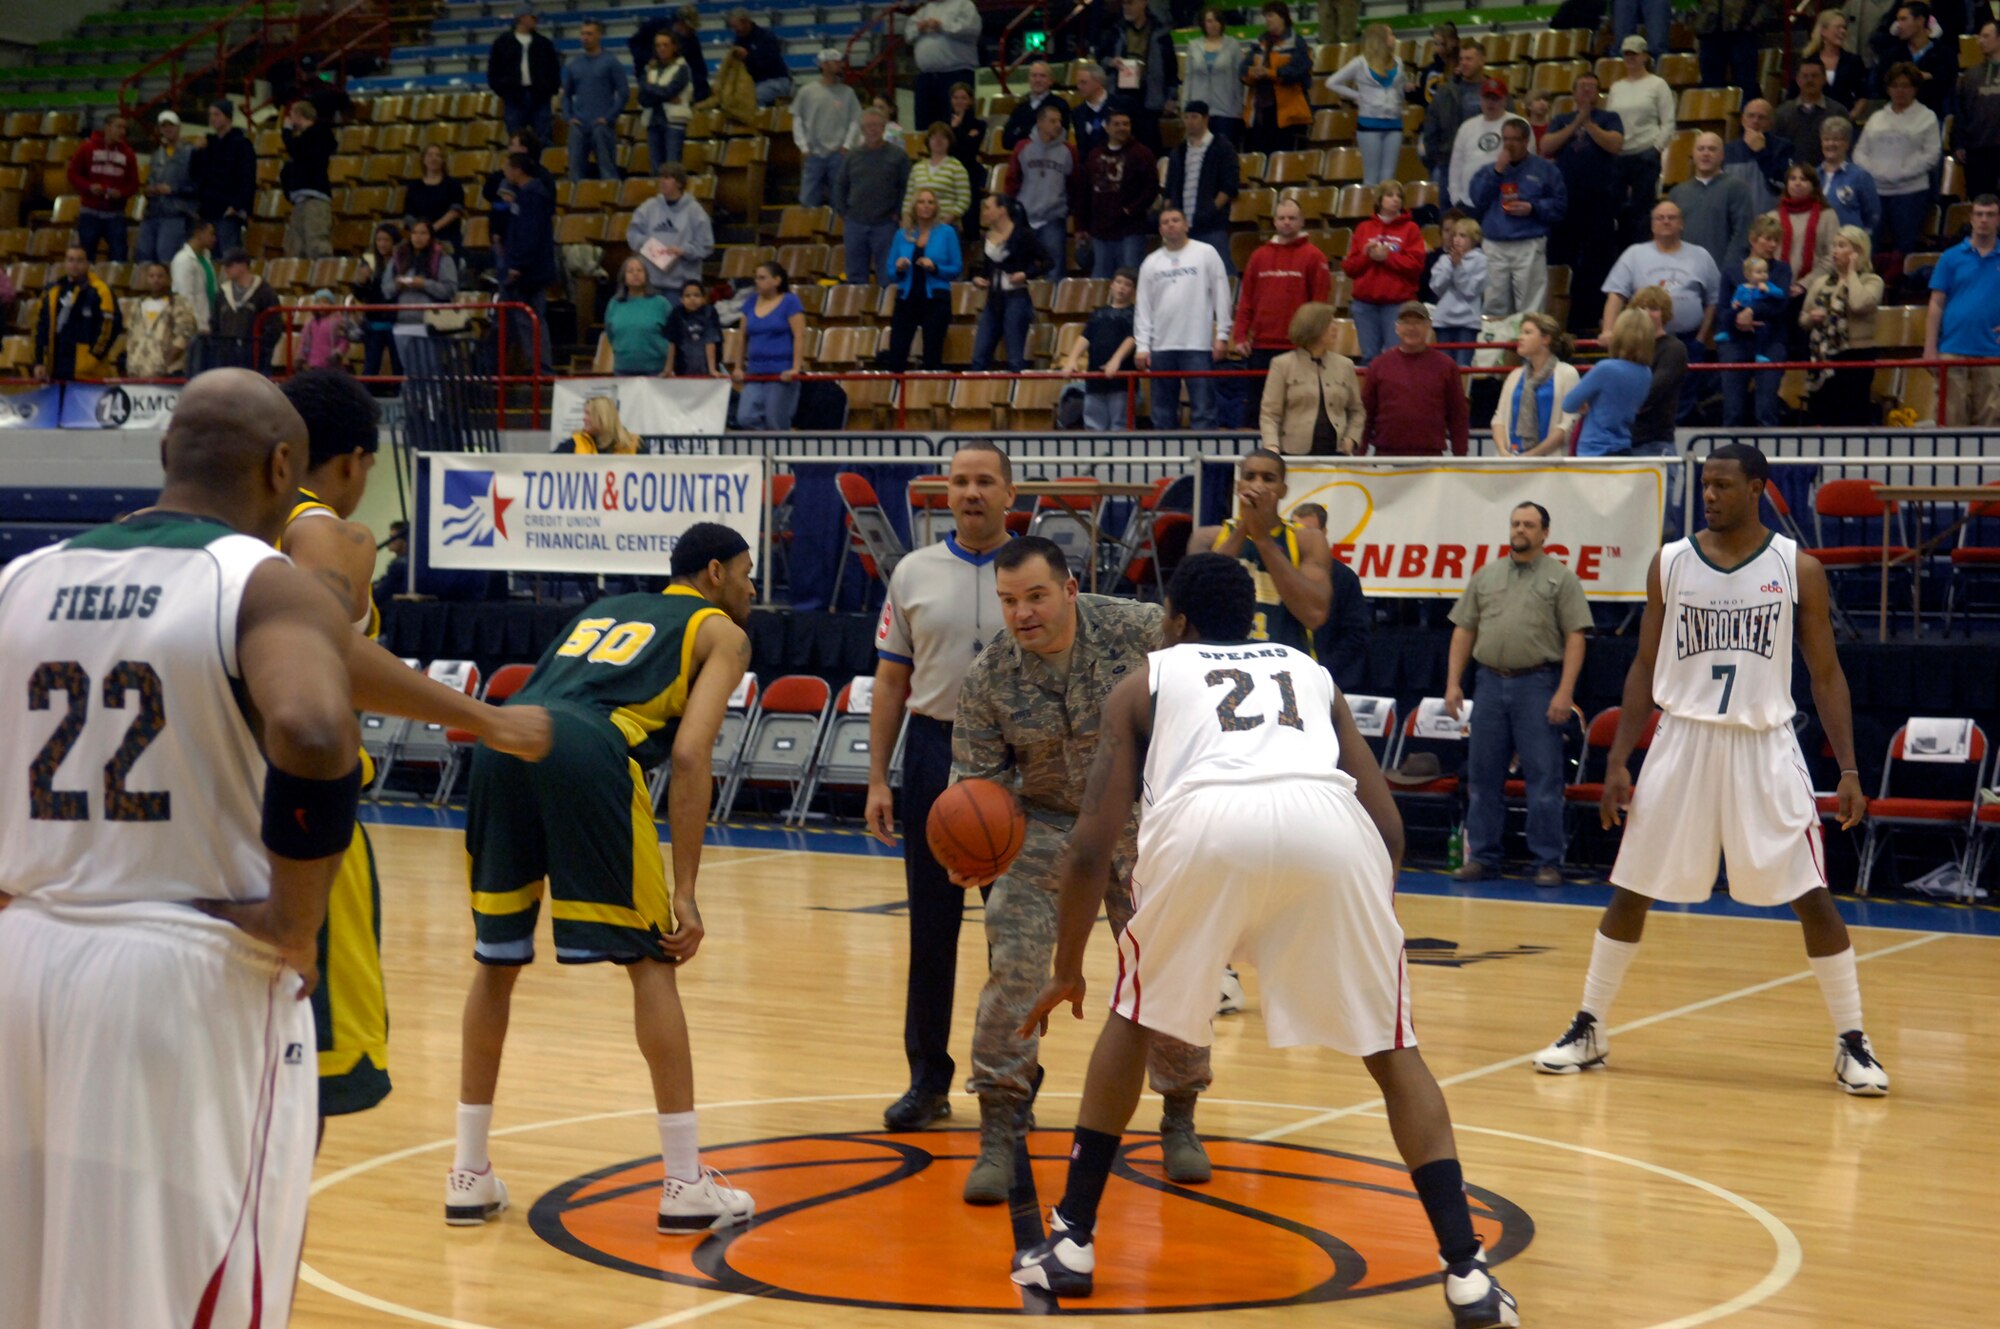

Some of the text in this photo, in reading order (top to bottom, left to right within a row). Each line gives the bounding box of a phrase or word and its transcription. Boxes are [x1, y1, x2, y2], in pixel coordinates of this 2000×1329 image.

[524, 515, 600, 528] CREDIT UNION
[525, 531, 610, 550] FINANCIAL
[1330, 543, 1602, 581] ENBRIE
[47, 584, 163, 621] FIELDS
[555, 617, 656, 667] 50
[1676, 601, 1782, 661] SKYROCKETS
[1198, 648, 1289, 661] SPEARS
[1204, 668, 1304, 732] 21
[1711, 664, 1737, 715] 7
[28, 660, 171, 821] 22
